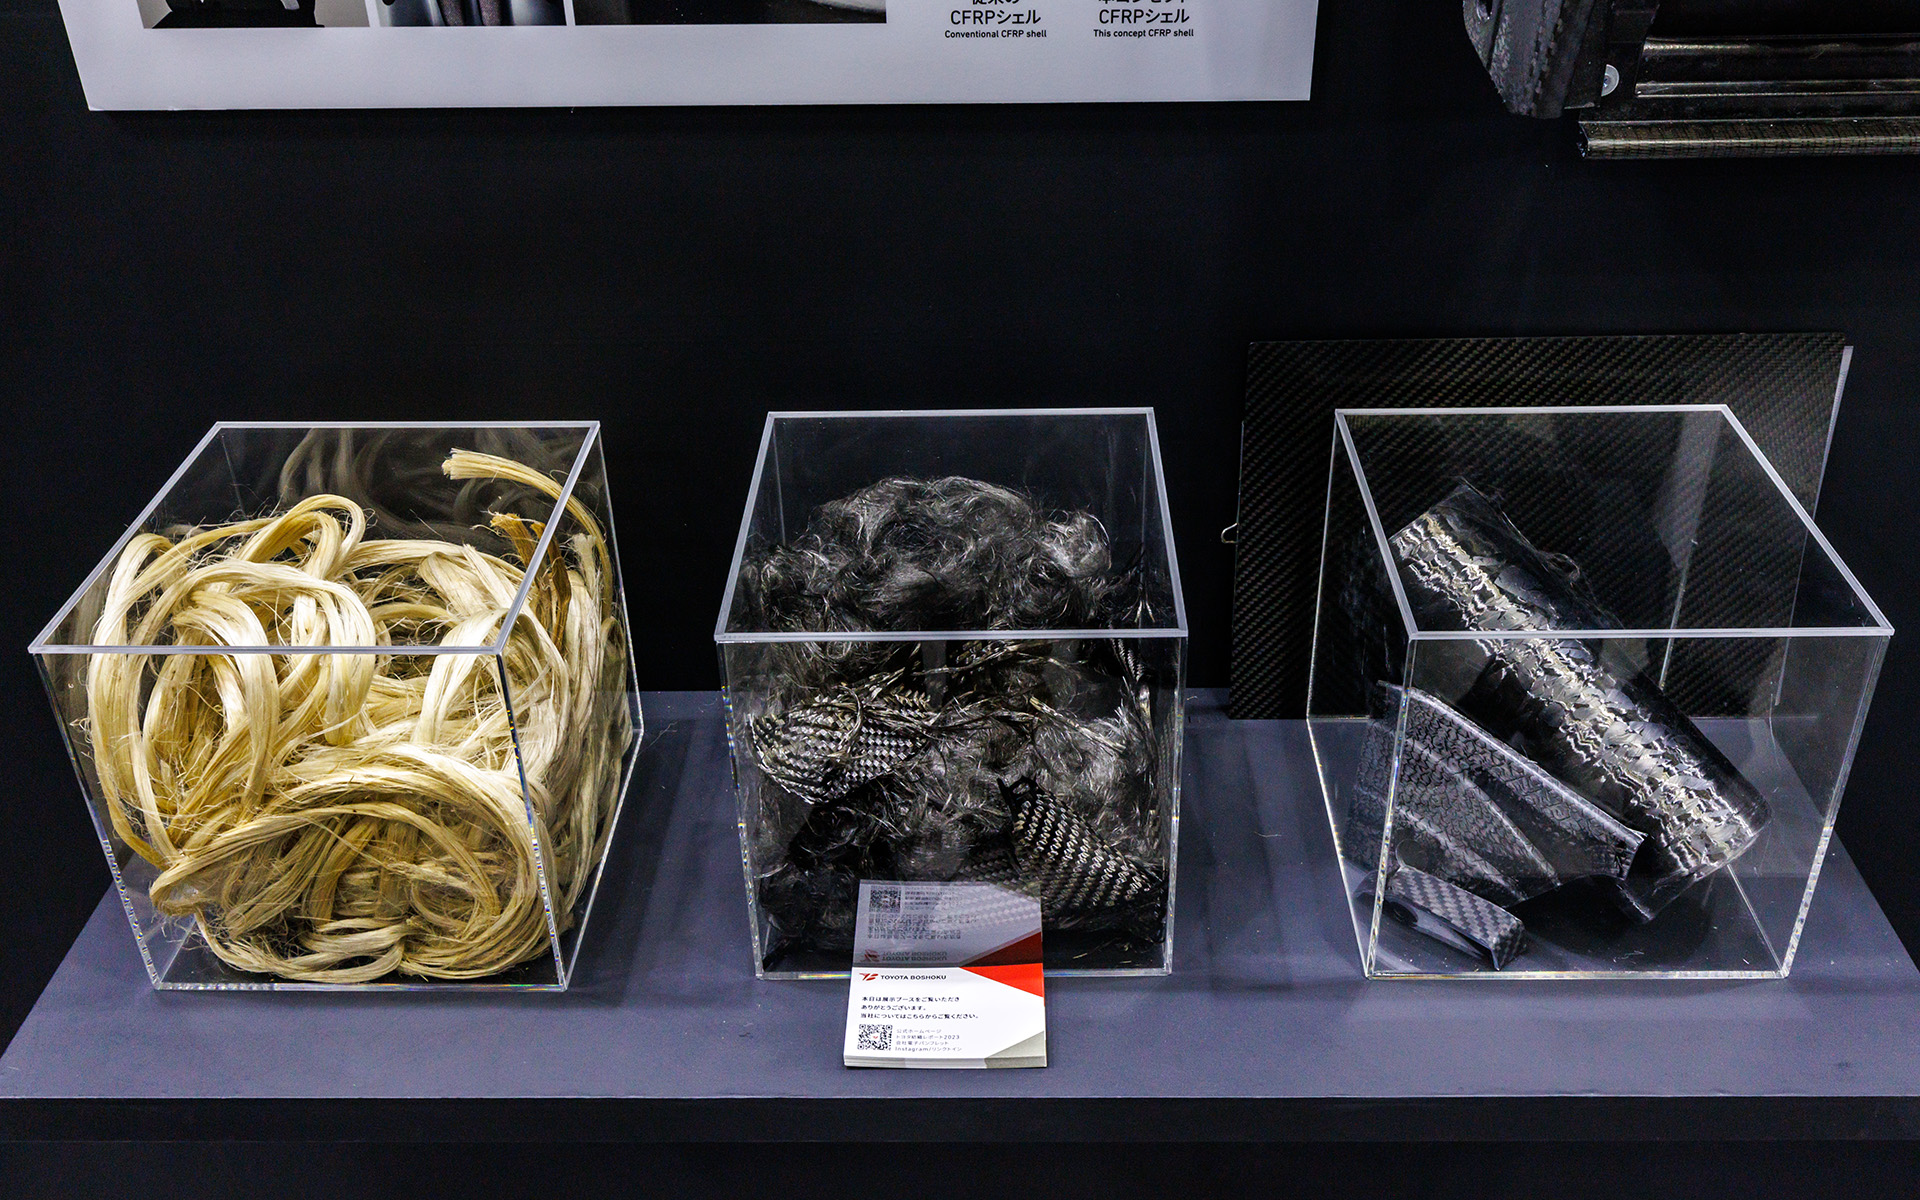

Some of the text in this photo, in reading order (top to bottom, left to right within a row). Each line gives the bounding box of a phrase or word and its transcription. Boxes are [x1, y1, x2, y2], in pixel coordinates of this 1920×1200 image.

[950, 9, 1041, 25] CFRPシェル
[1099, 8, 1190, 24] CFRPシェル
[944, 29, 1047, 38] Conventional CFRP shell
[1093, 28, 1194, 39] This concept CFRP shell
